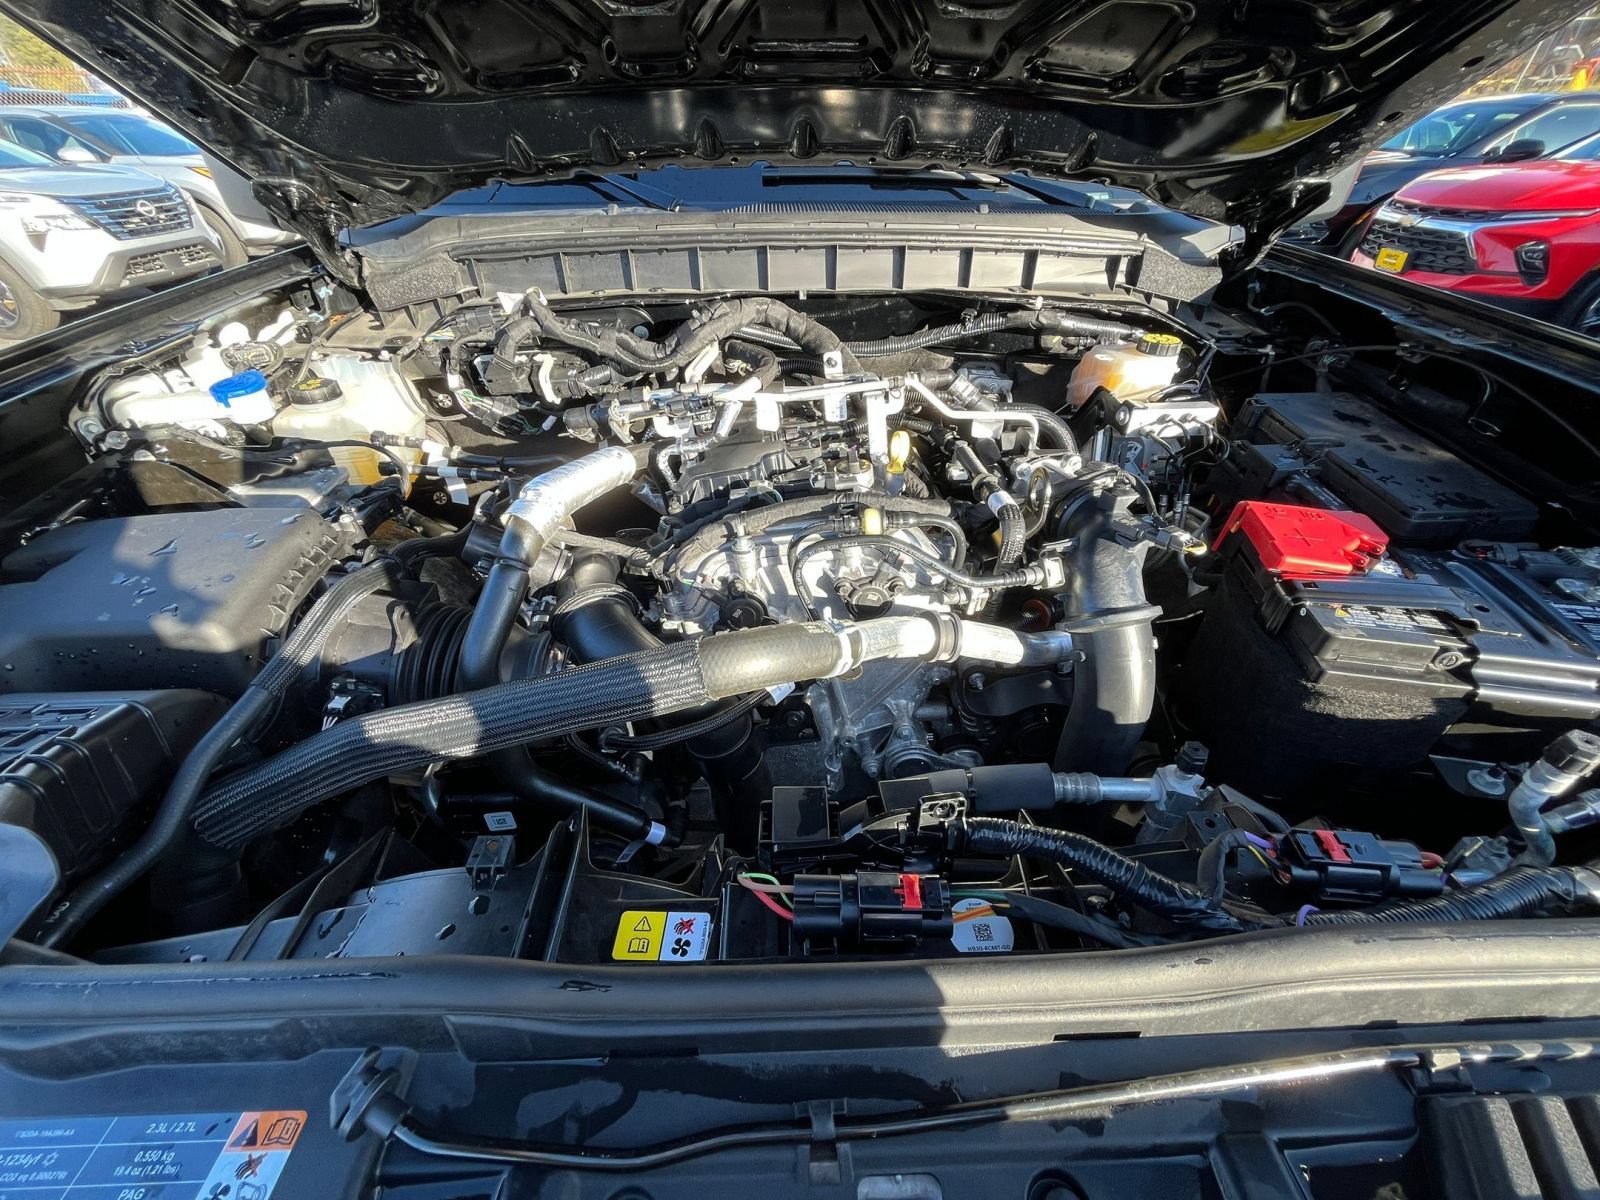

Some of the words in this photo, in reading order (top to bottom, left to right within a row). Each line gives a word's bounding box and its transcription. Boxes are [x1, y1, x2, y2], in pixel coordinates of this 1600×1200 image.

[146, 1123, 168, 1133] 2.3L
[175, 1122, 196, 1132] 2.7L
[134, 1151, 162, 1163] 0.550
[161, 1151, 175, 1164] kg
[113, 1166, 132, 1176] 19.4
[131, 1168, 142, 1176] oz
[117, 1188, 145, 1200] PAG
